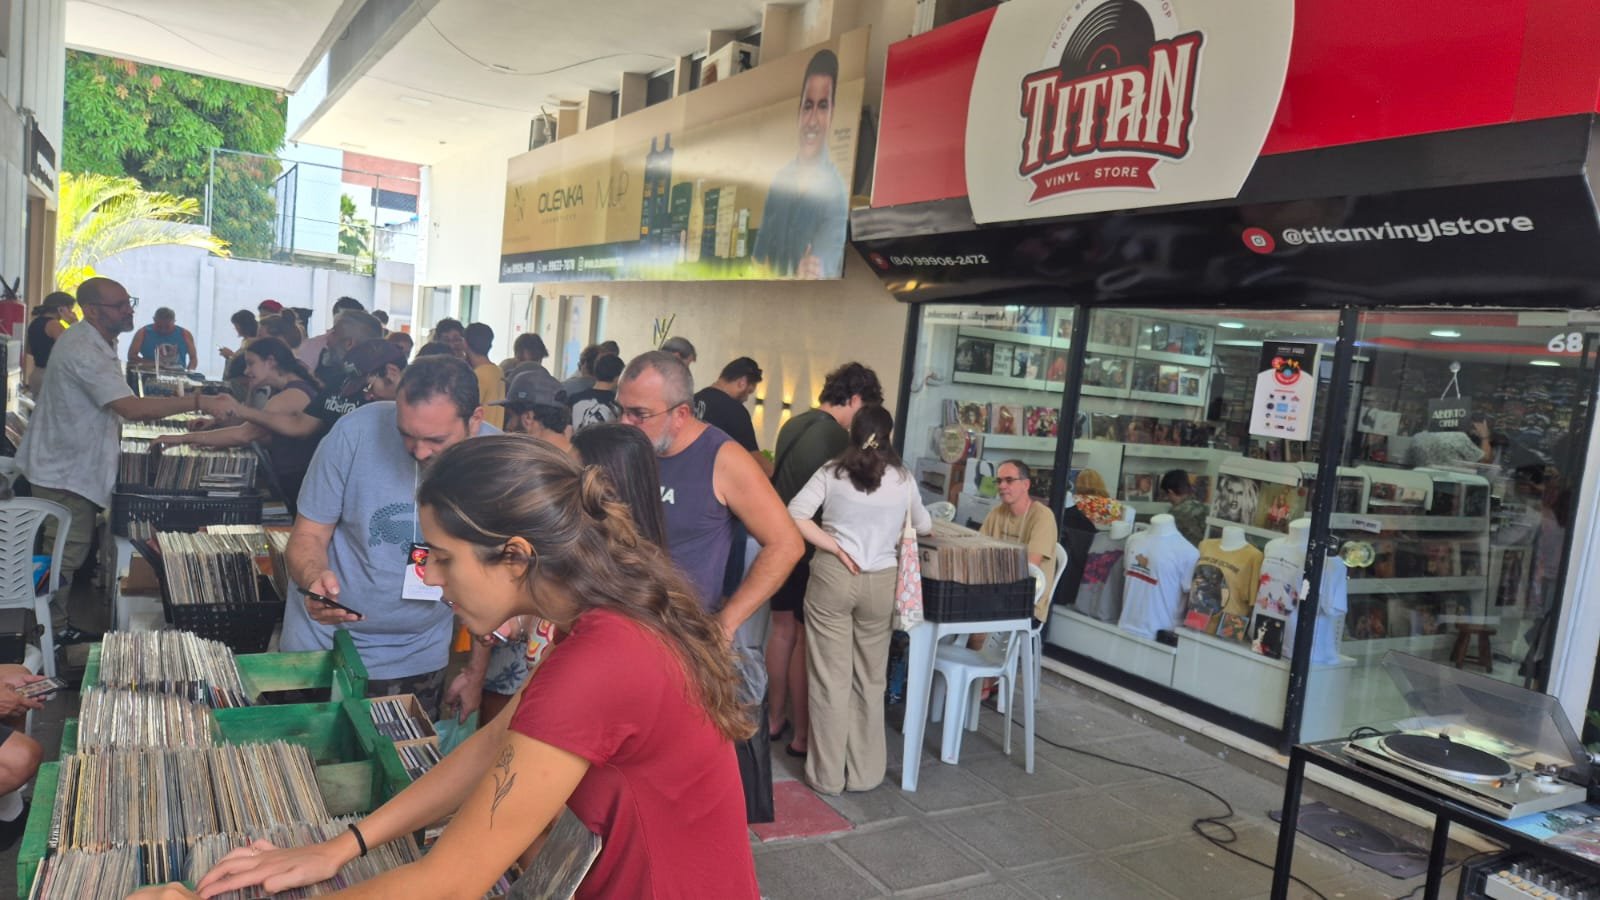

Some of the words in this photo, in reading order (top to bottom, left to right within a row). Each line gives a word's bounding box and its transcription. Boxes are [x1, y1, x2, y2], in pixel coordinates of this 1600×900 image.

[1021, 40, 1197, 169] TITAN
[1045, 172, 1081, 188] VINYL
[1094, 167, 1138, 180] STORE
[537, 183, 584, 214] OLENKA
[1282, 215, 1534, 246] @titanvinylstore
[1547, 332, 1584, 352] 68
